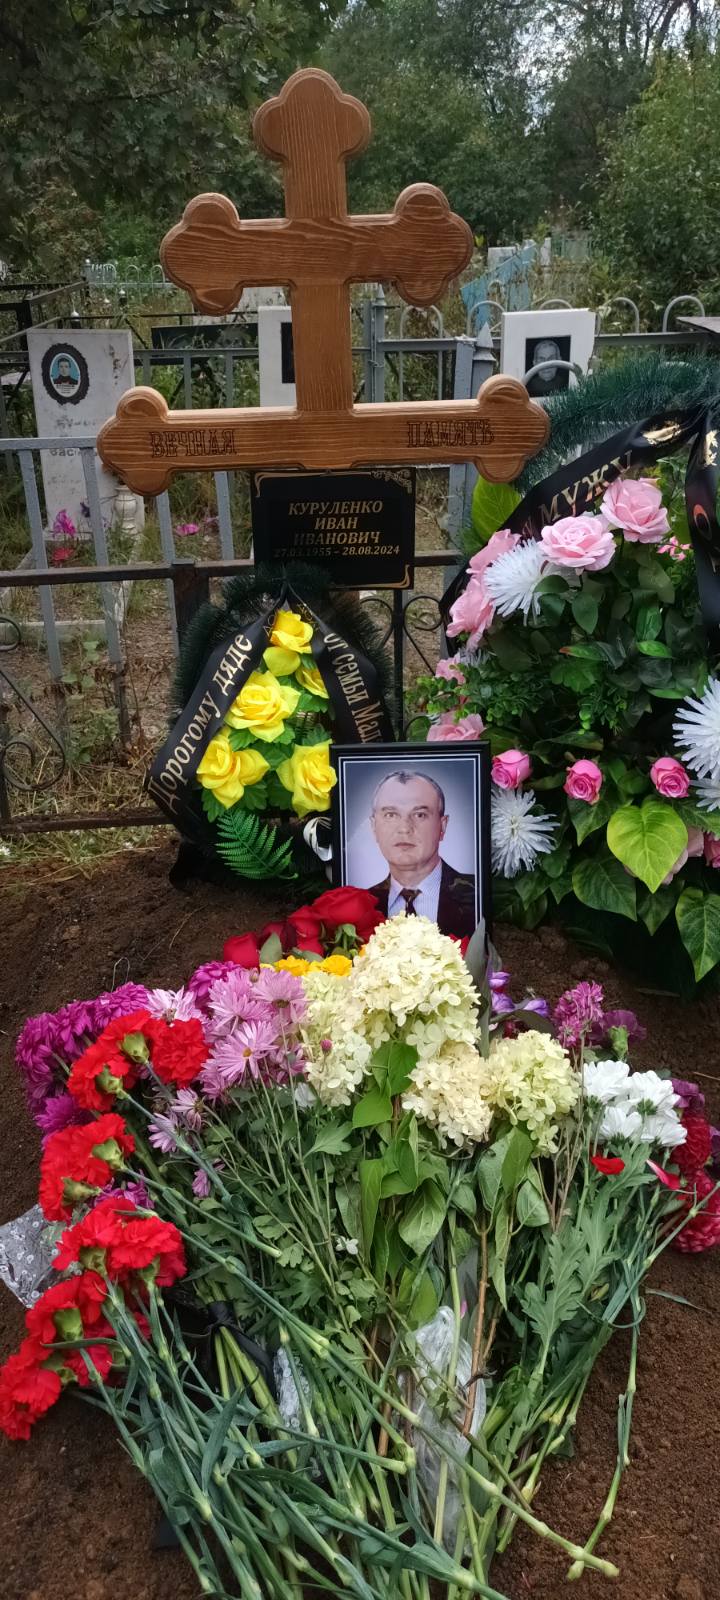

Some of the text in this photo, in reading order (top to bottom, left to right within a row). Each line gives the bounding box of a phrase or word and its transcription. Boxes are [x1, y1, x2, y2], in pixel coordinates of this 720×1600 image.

[149, 418, 495, 458] ВЕЧНАЯ ПАМЯТЬ
[288, 500, 383, 516] КУРУЛЕНКО
[314, 516, 359, 530] ИВАН
[294, 531, 381, 546] ИВАНОВИЧ
[342, 545, 400, 556] 28.08.2024
[323, 632, 385, 744] от семьи Мал
[147, 633, 253, 815] Дорогому дяде
